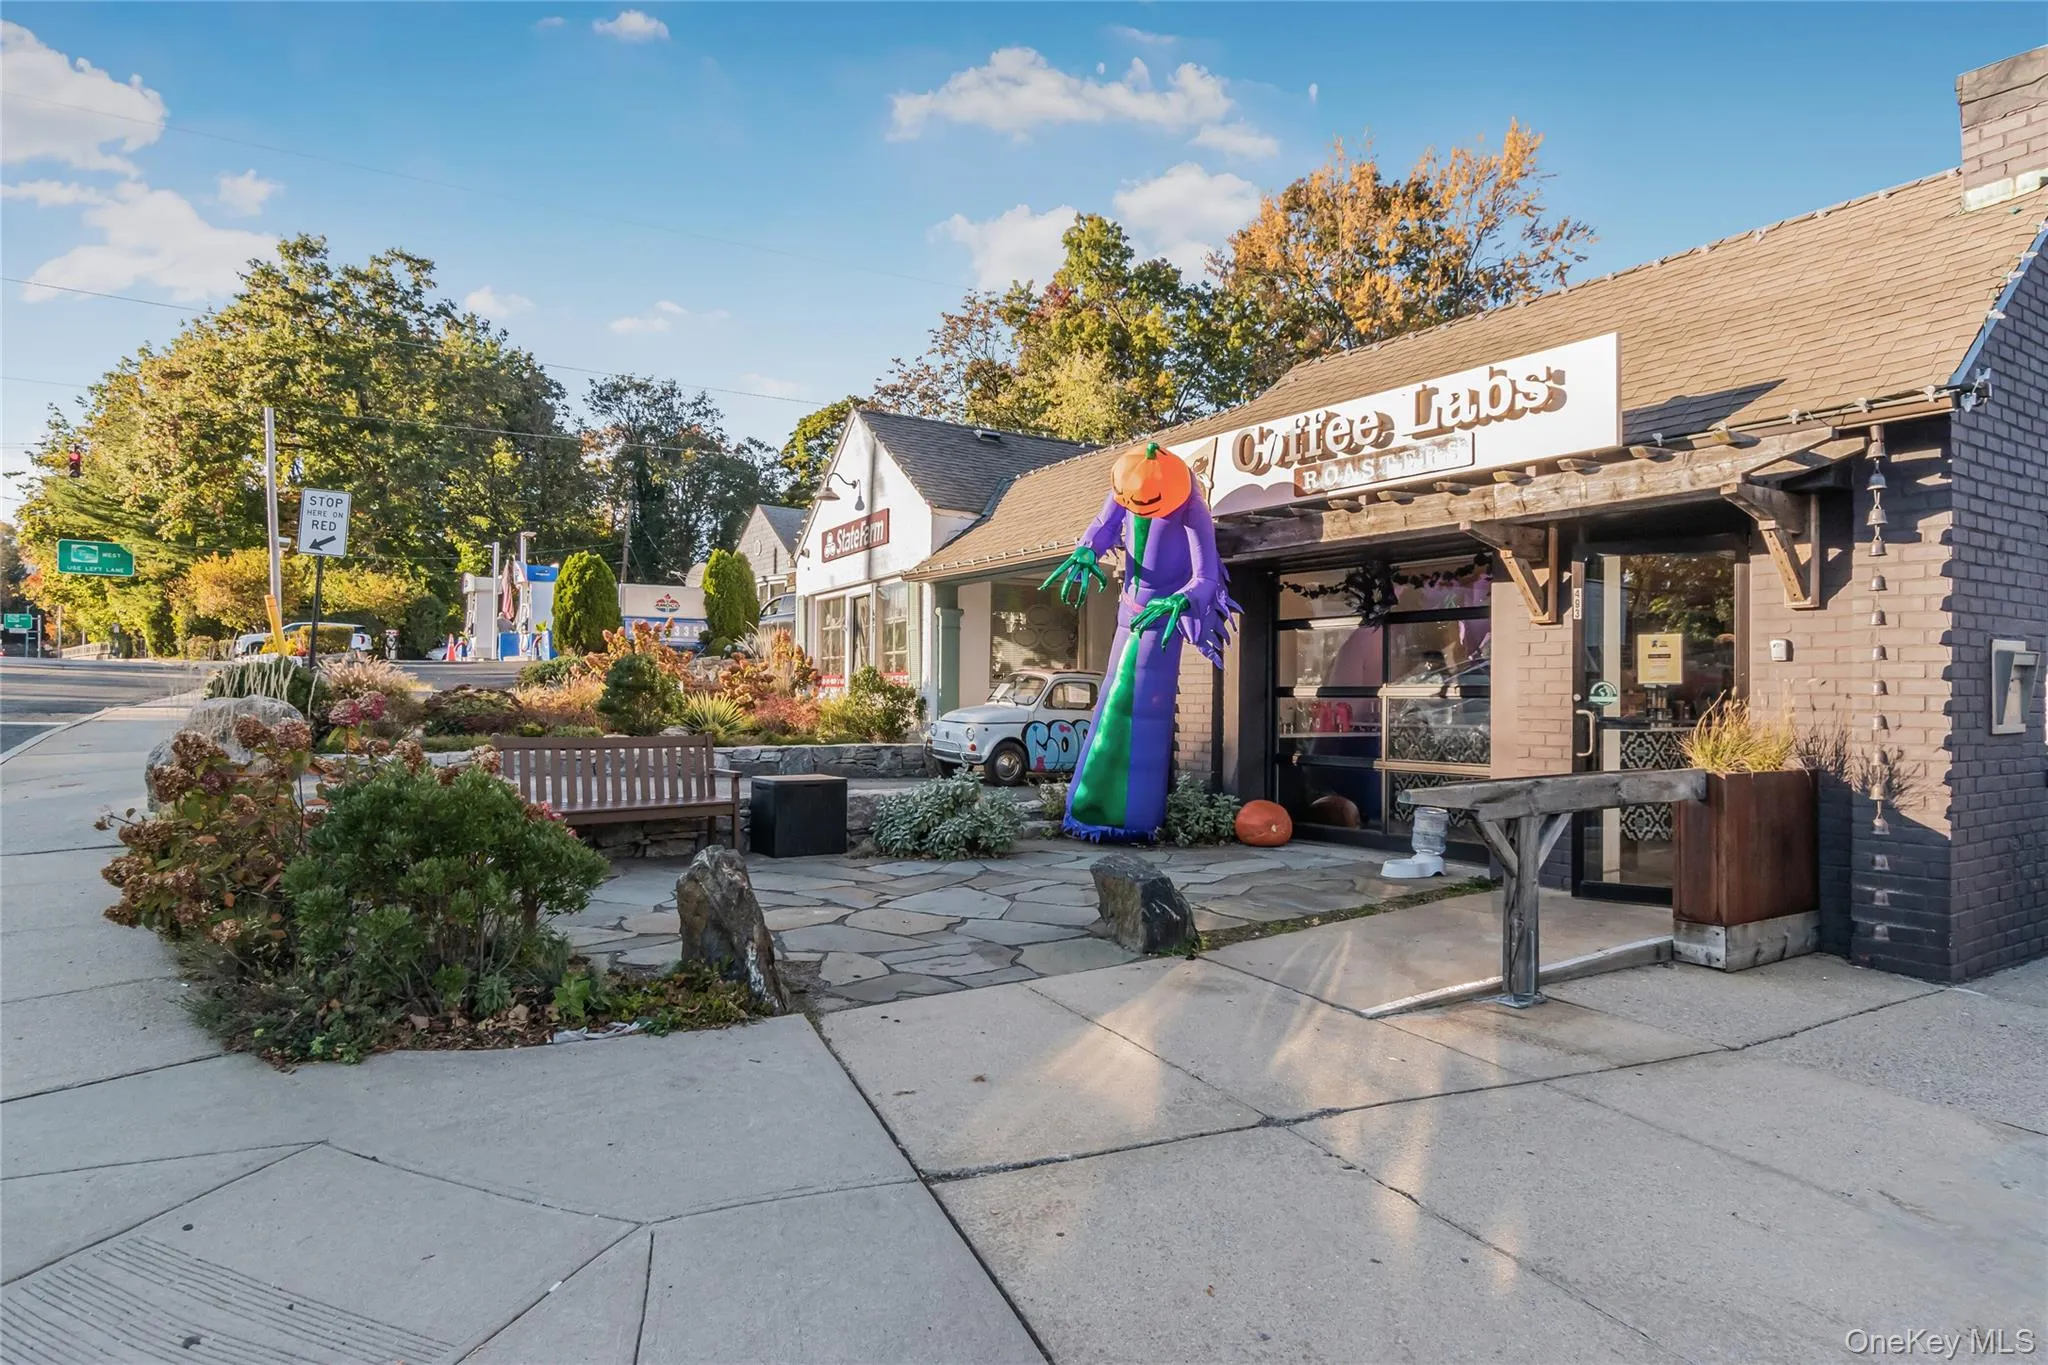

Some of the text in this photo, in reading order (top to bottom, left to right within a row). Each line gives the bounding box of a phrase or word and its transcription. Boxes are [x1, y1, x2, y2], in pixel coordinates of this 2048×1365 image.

[1232, 365, 1560, 475] Coffee Labs
[309, 495, 343, 508] STOP
[306, 509, 327, 517] HERE
[311, 519, 337, 531] RED
